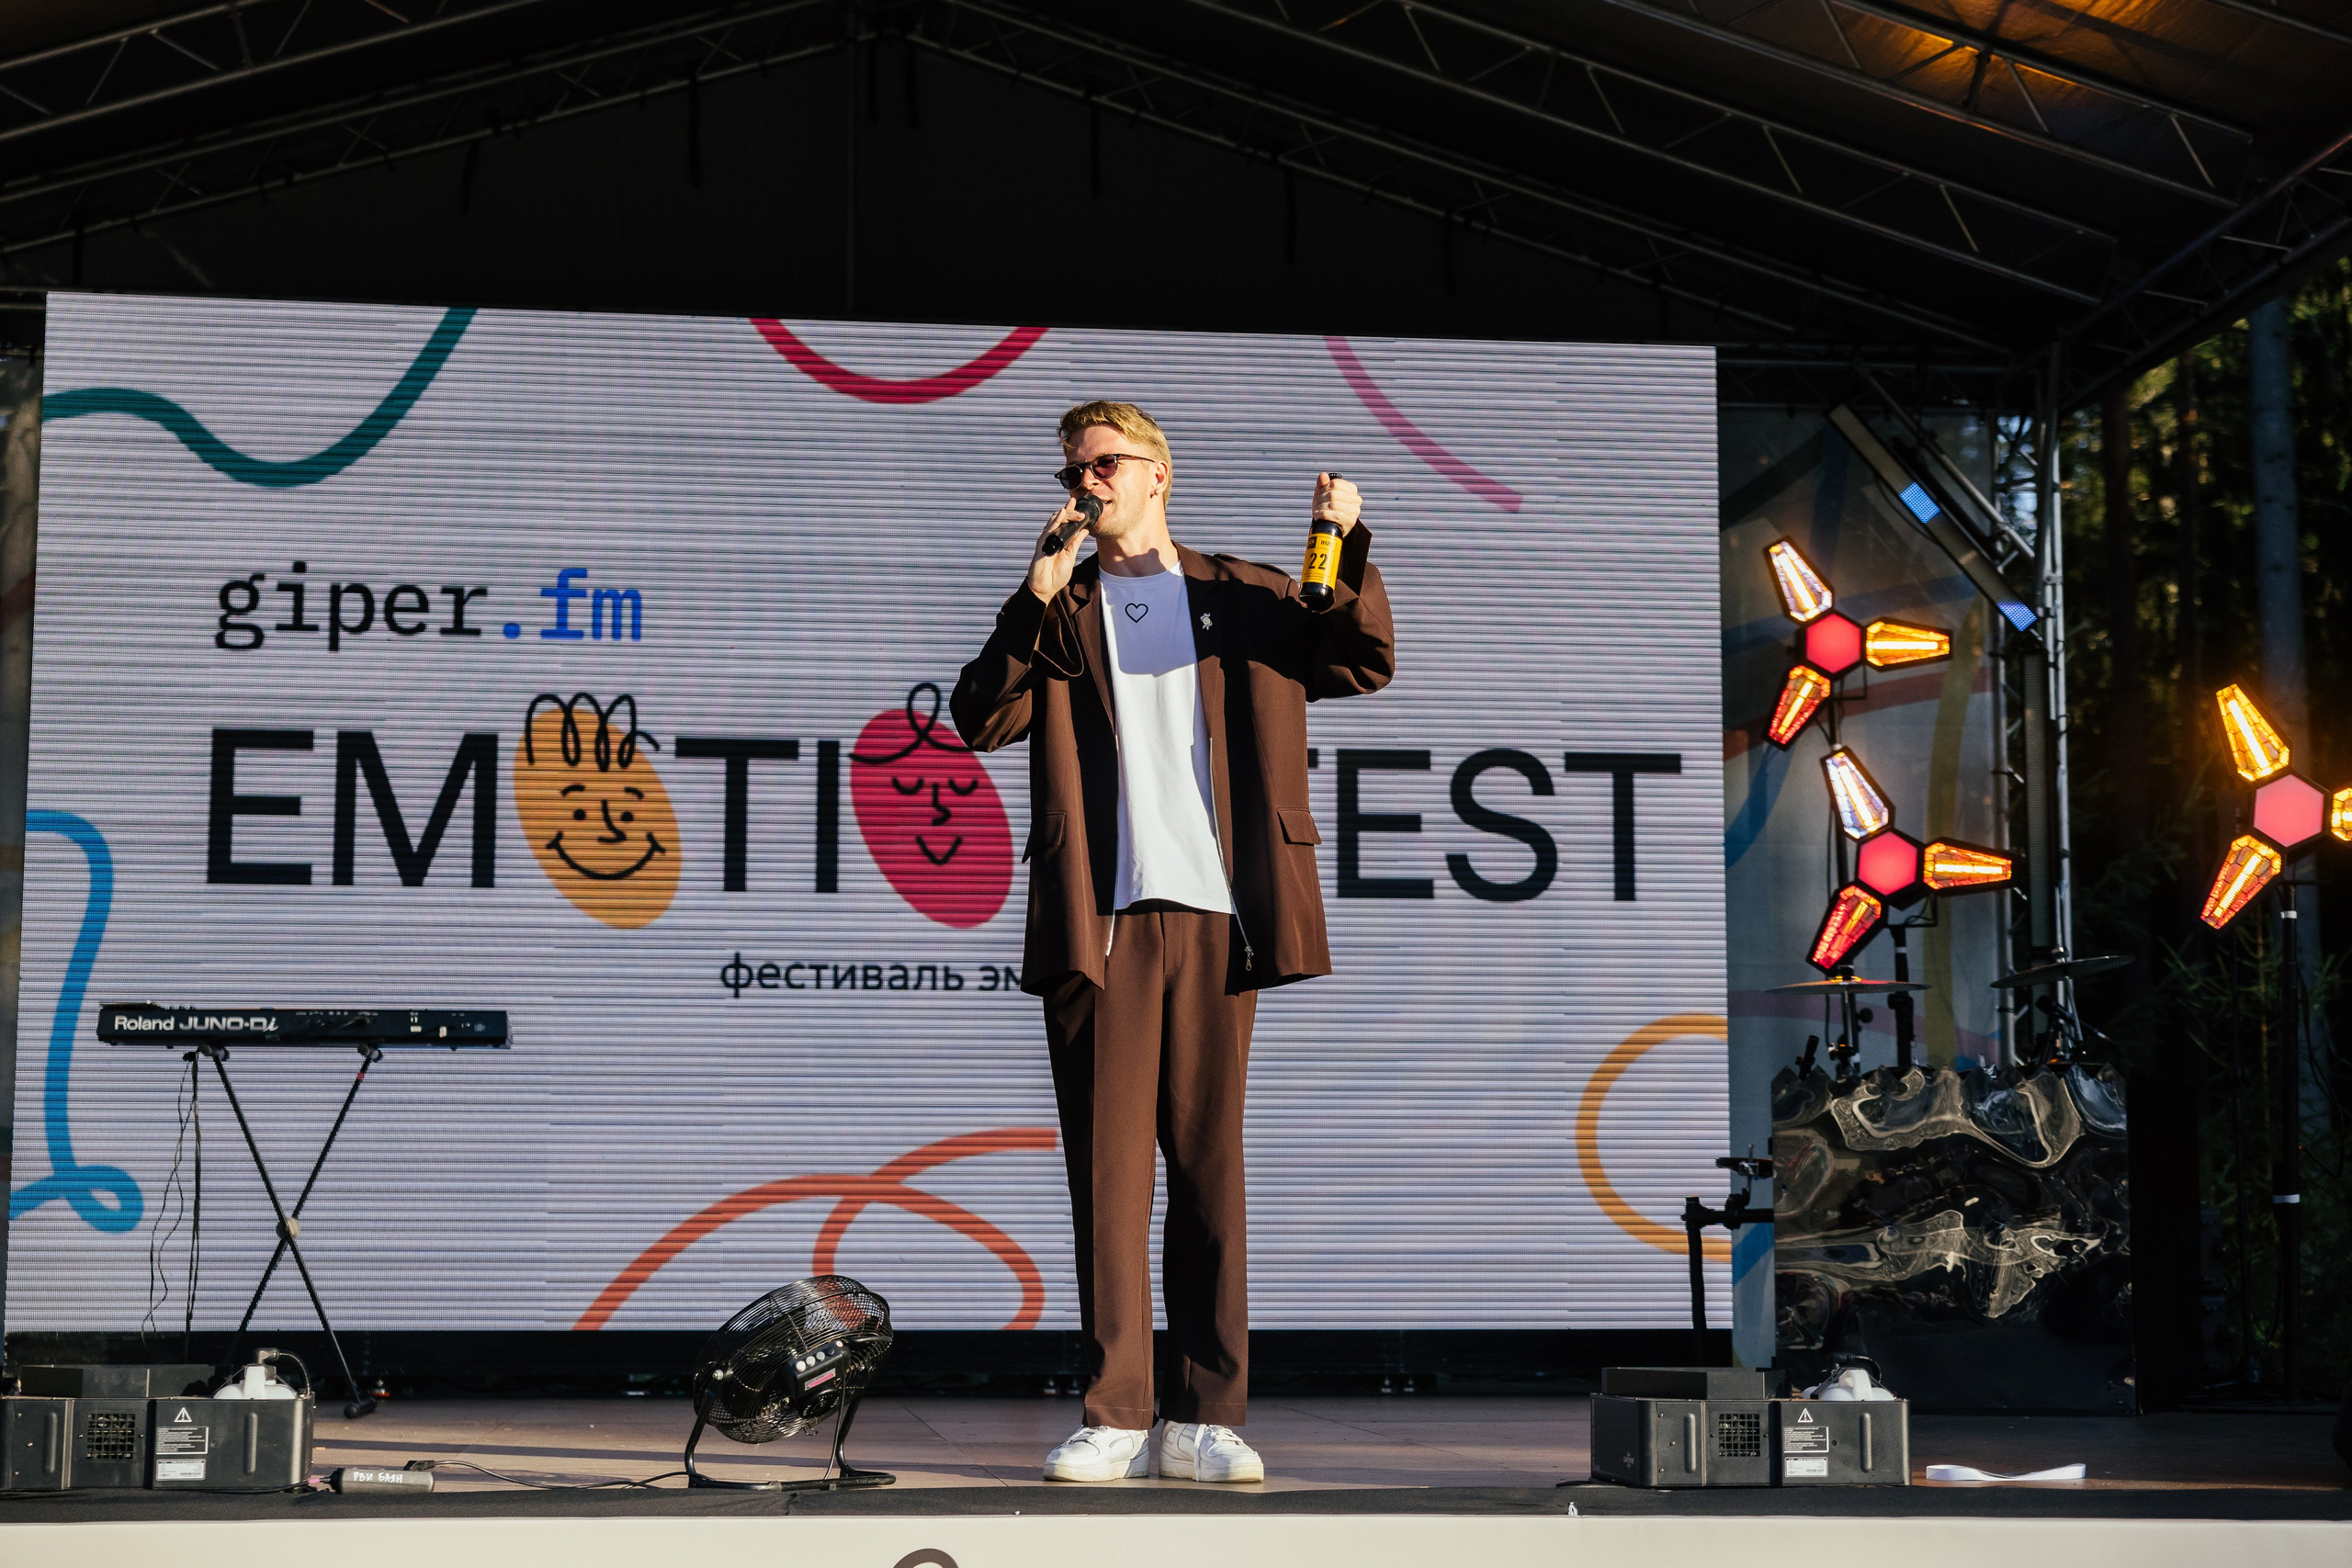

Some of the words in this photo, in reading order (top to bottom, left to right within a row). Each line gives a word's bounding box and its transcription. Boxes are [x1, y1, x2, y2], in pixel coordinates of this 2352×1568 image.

[1308, 553, 1328, 570] 22
[214, 561, 643, 652] giper.fm
[1307, 748, 1682, 902] EST
[720, 952, 963, 998] фестиваль
[114, 1015, 175, 1031] Roland
